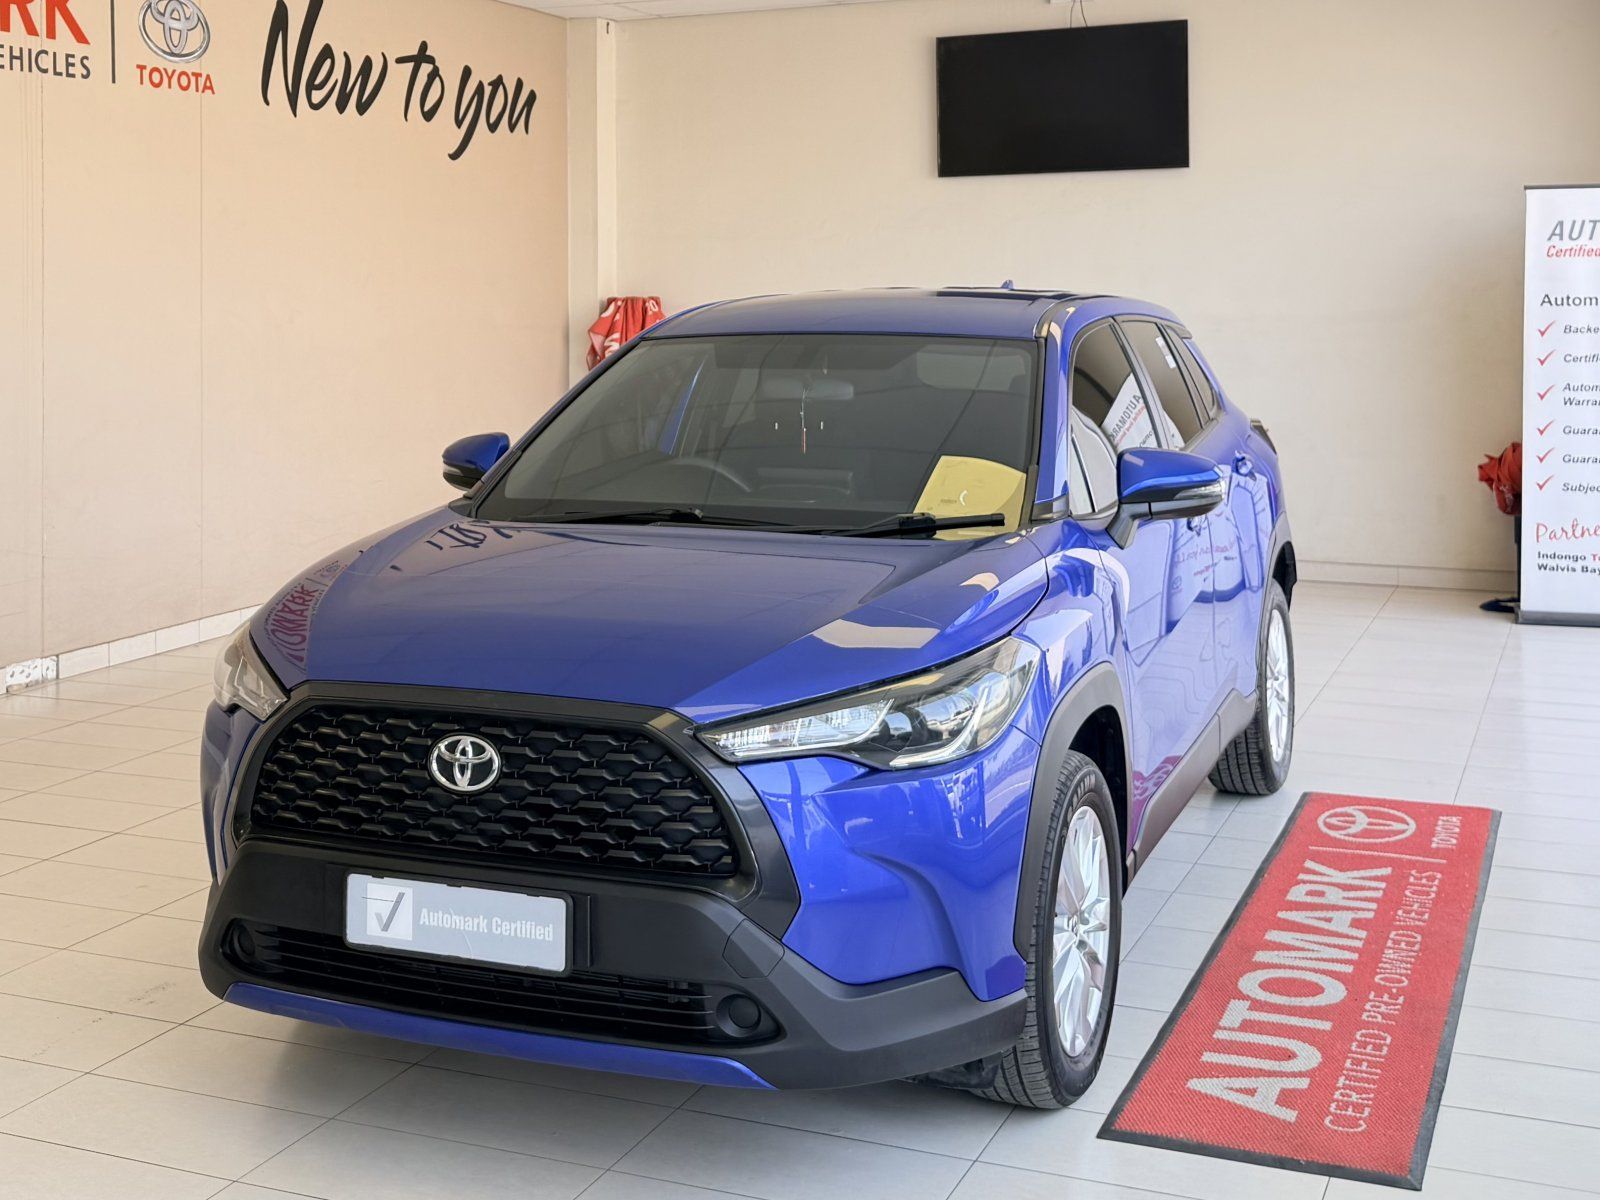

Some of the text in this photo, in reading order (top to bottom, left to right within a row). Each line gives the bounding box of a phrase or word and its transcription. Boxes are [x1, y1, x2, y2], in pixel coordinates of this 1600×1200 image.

[136, 64, 215, 95] TOYOTA
[261, 0, 537, 161] New to you
[1546, 219, 1600, 241] AUT
[1540, 293, 1599, 306] Autom
[1563, 353, 1600, 363] Certifi
[1563, 396, 1600, 406] Warra
[1562, 425, 1600, 435] Guara
[1562, 454, 1600, 464] Guara
[1537, 550, 1586, 562] Indongo
[1537, 563, 1577, 572] Walvis
[1431, 815, 1462, 849] TOYOTA
[419, 907, 554, 941] Automark Certified
[1187, 859, 1392, 1123] AUTOMARK
[1324, 869, 1442, 1133] CERTIFIED PRE-OWNED VEHICLES
